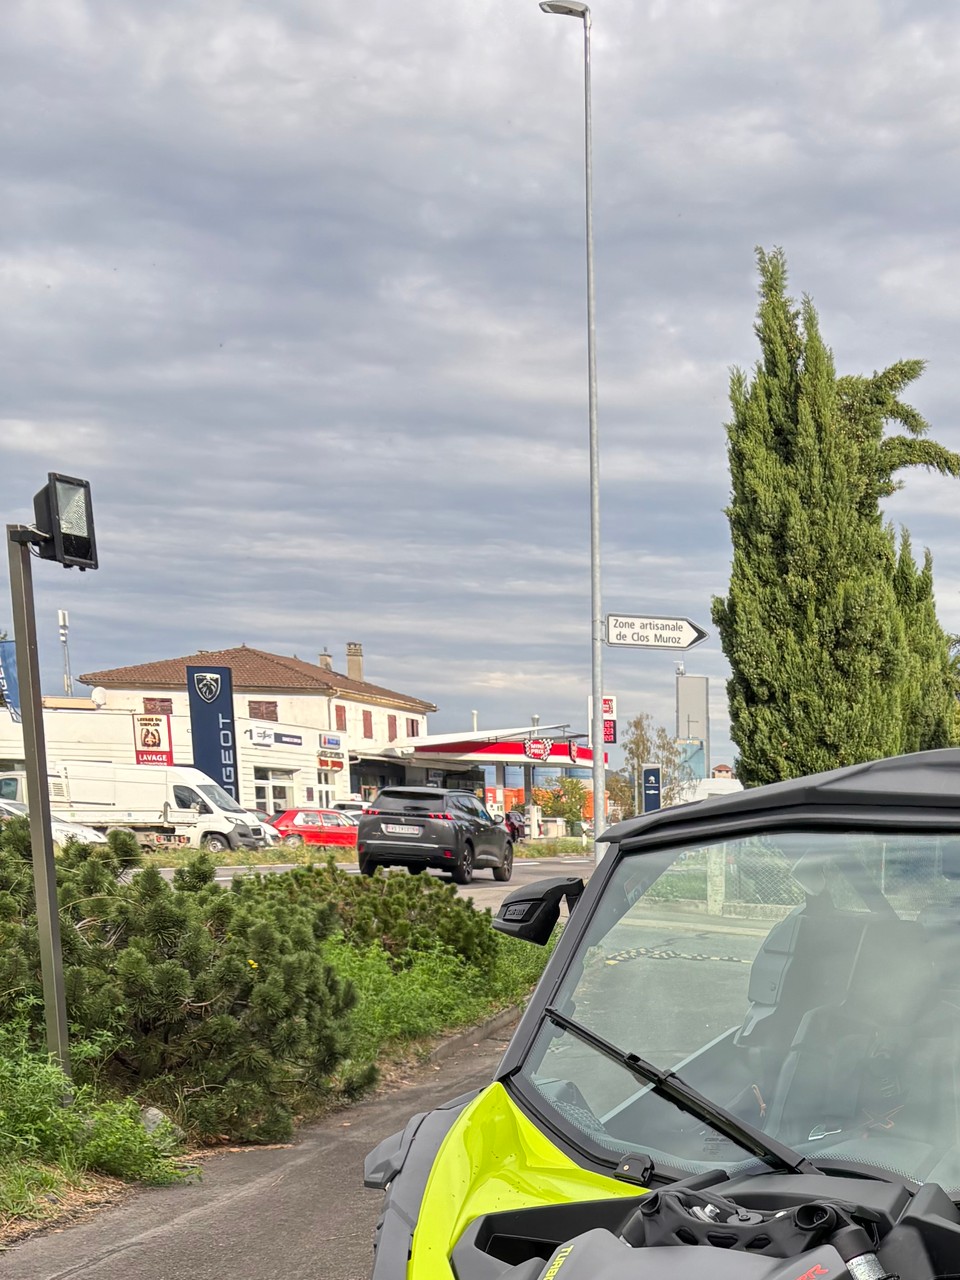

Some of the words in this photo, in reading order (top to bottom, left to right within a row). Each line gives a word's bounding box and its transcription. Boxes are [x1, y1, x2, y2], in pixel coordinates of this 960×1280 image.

[613, 618, 635, 629] Zone
[640, 621, 684, 632] artisanale
[616, 631, 627, 641] de
[631, 632, 650, 643] Clos
[654, 633, 682, 645] Muroz
[219, 713, 236, 800] UGEOT
